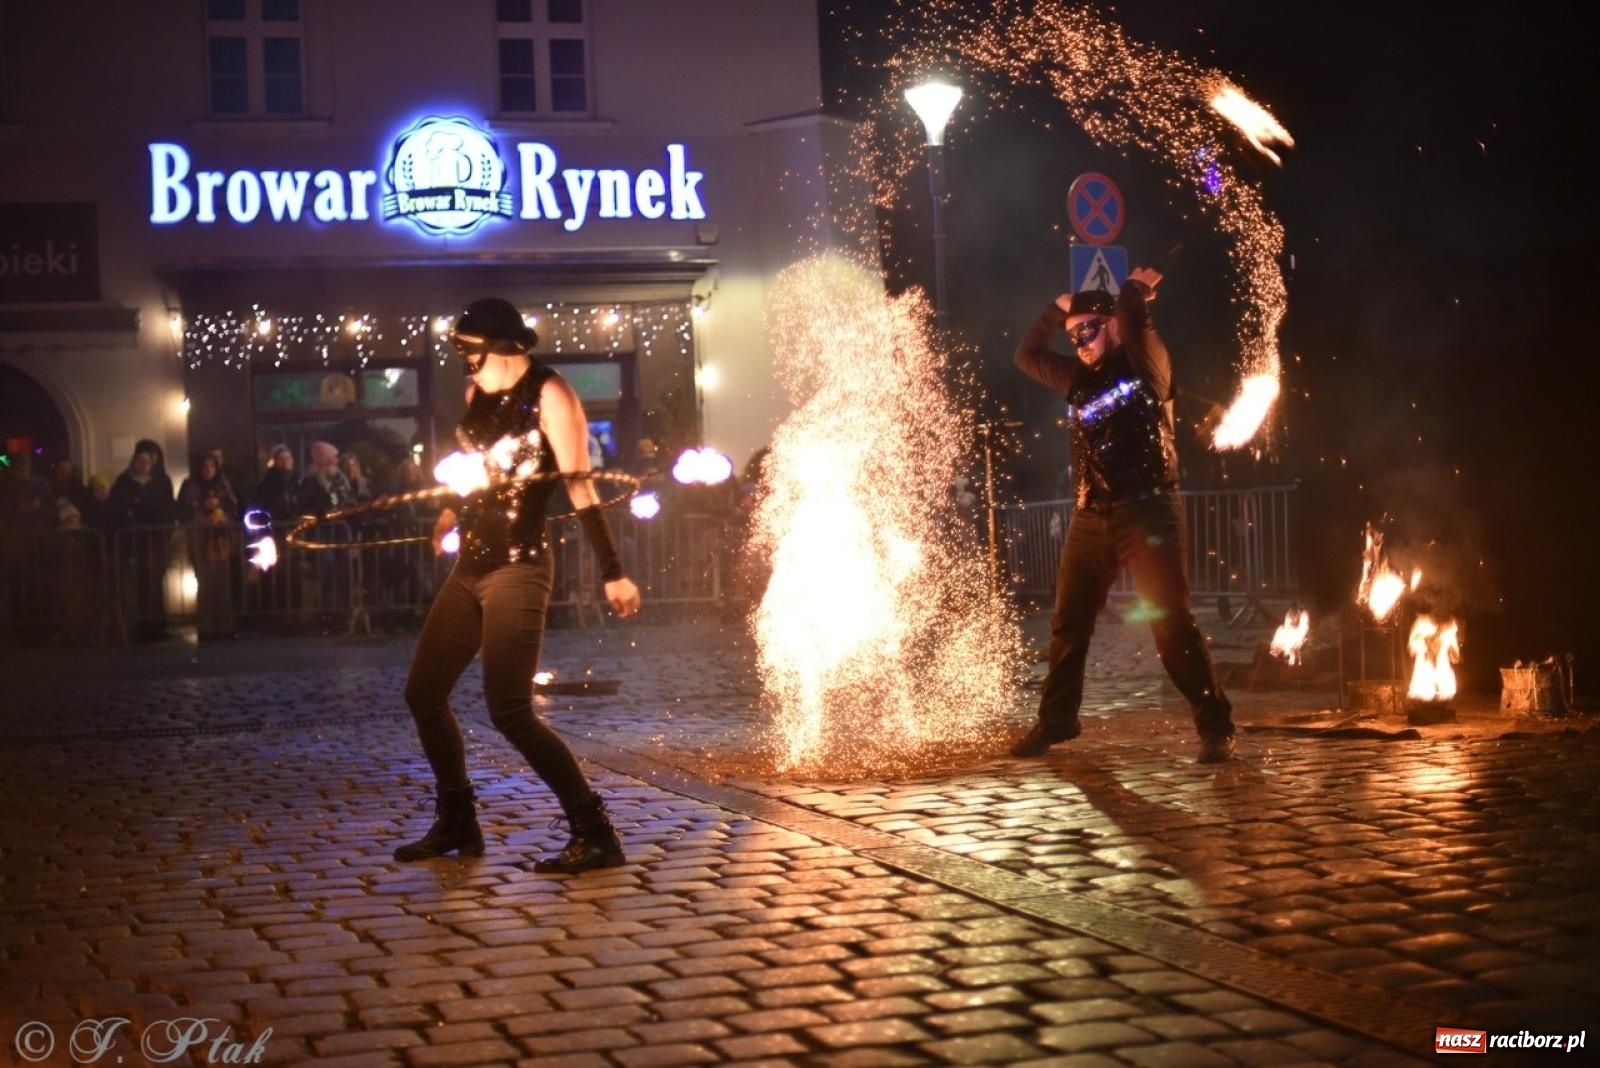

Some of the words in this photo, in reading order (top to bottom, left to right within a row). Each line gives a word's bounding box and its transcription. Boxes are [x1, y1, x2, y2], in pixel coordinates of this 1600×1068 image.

[149, 142, 377, 225] Browar
[518, 142, 706, 231] Rynek
[398, 191, 453, 214] Browar
[453, 188, 500, 213] Rynek
